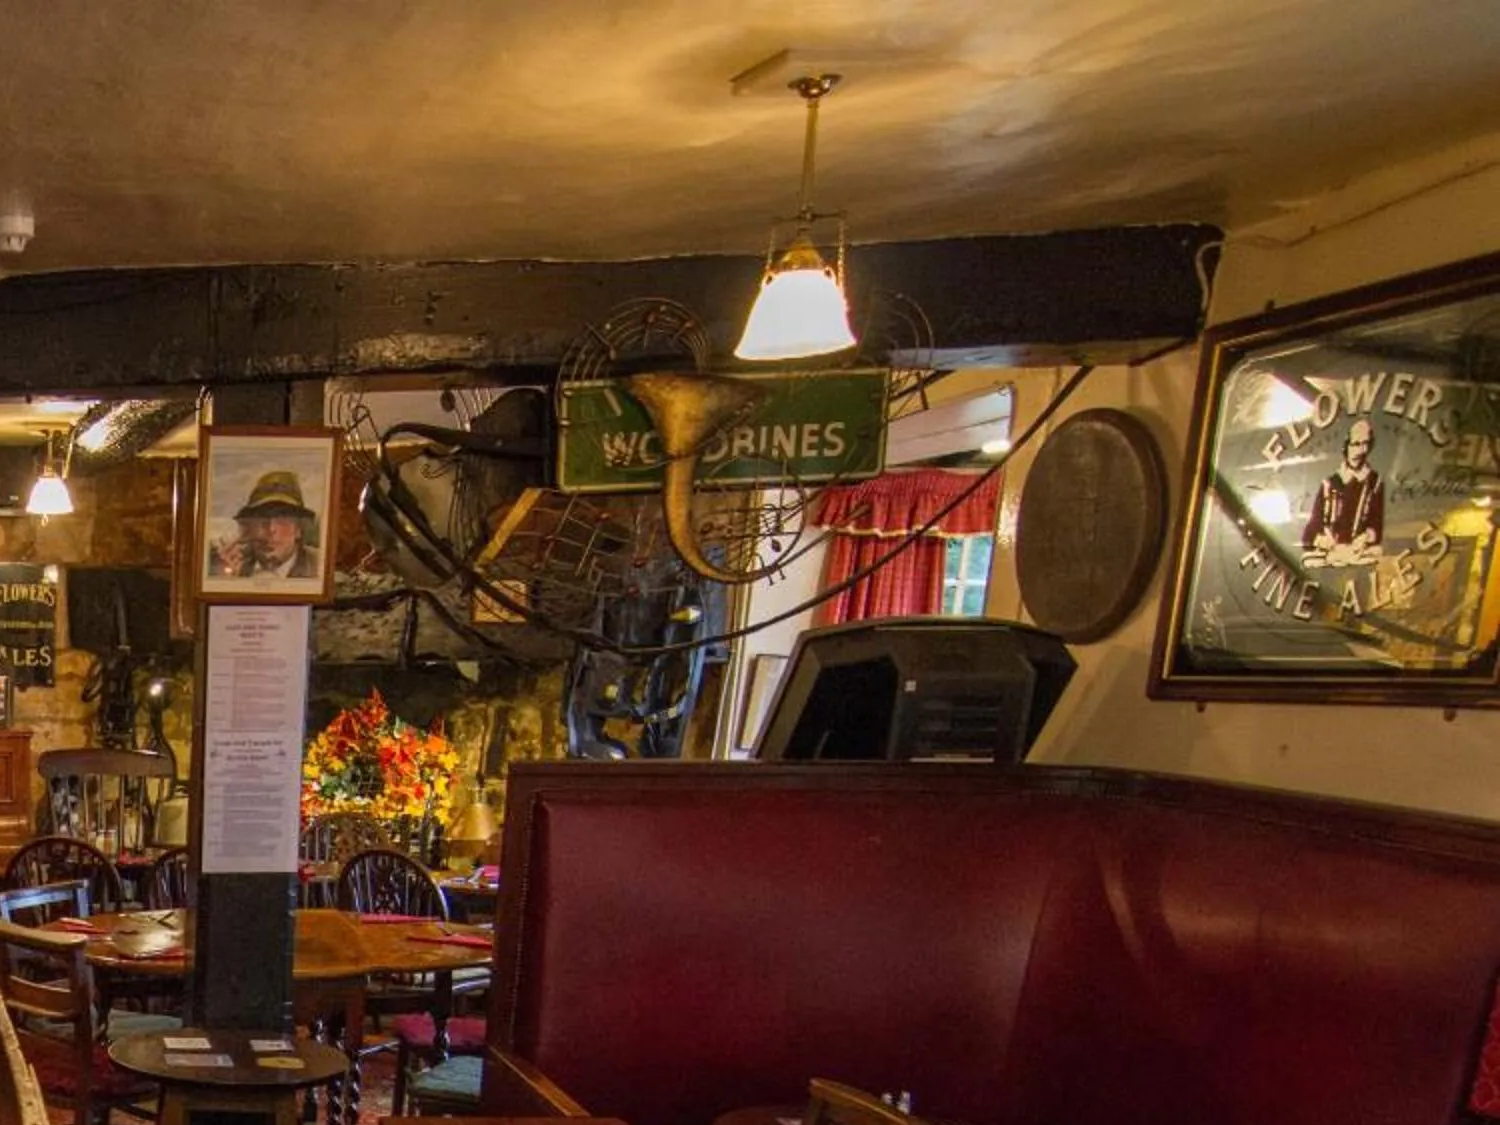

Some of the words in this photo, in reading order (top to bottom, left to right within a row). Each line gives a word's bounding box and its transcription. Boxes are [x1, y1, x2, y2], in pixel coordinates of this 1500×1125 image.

[602, 420, 847, 467] WODBINES
[1262, 371, 1451, 472] FLOWERS
[1239, 542, 1321, 620] FINE
[1337, 521, 1449, 620] ALES
